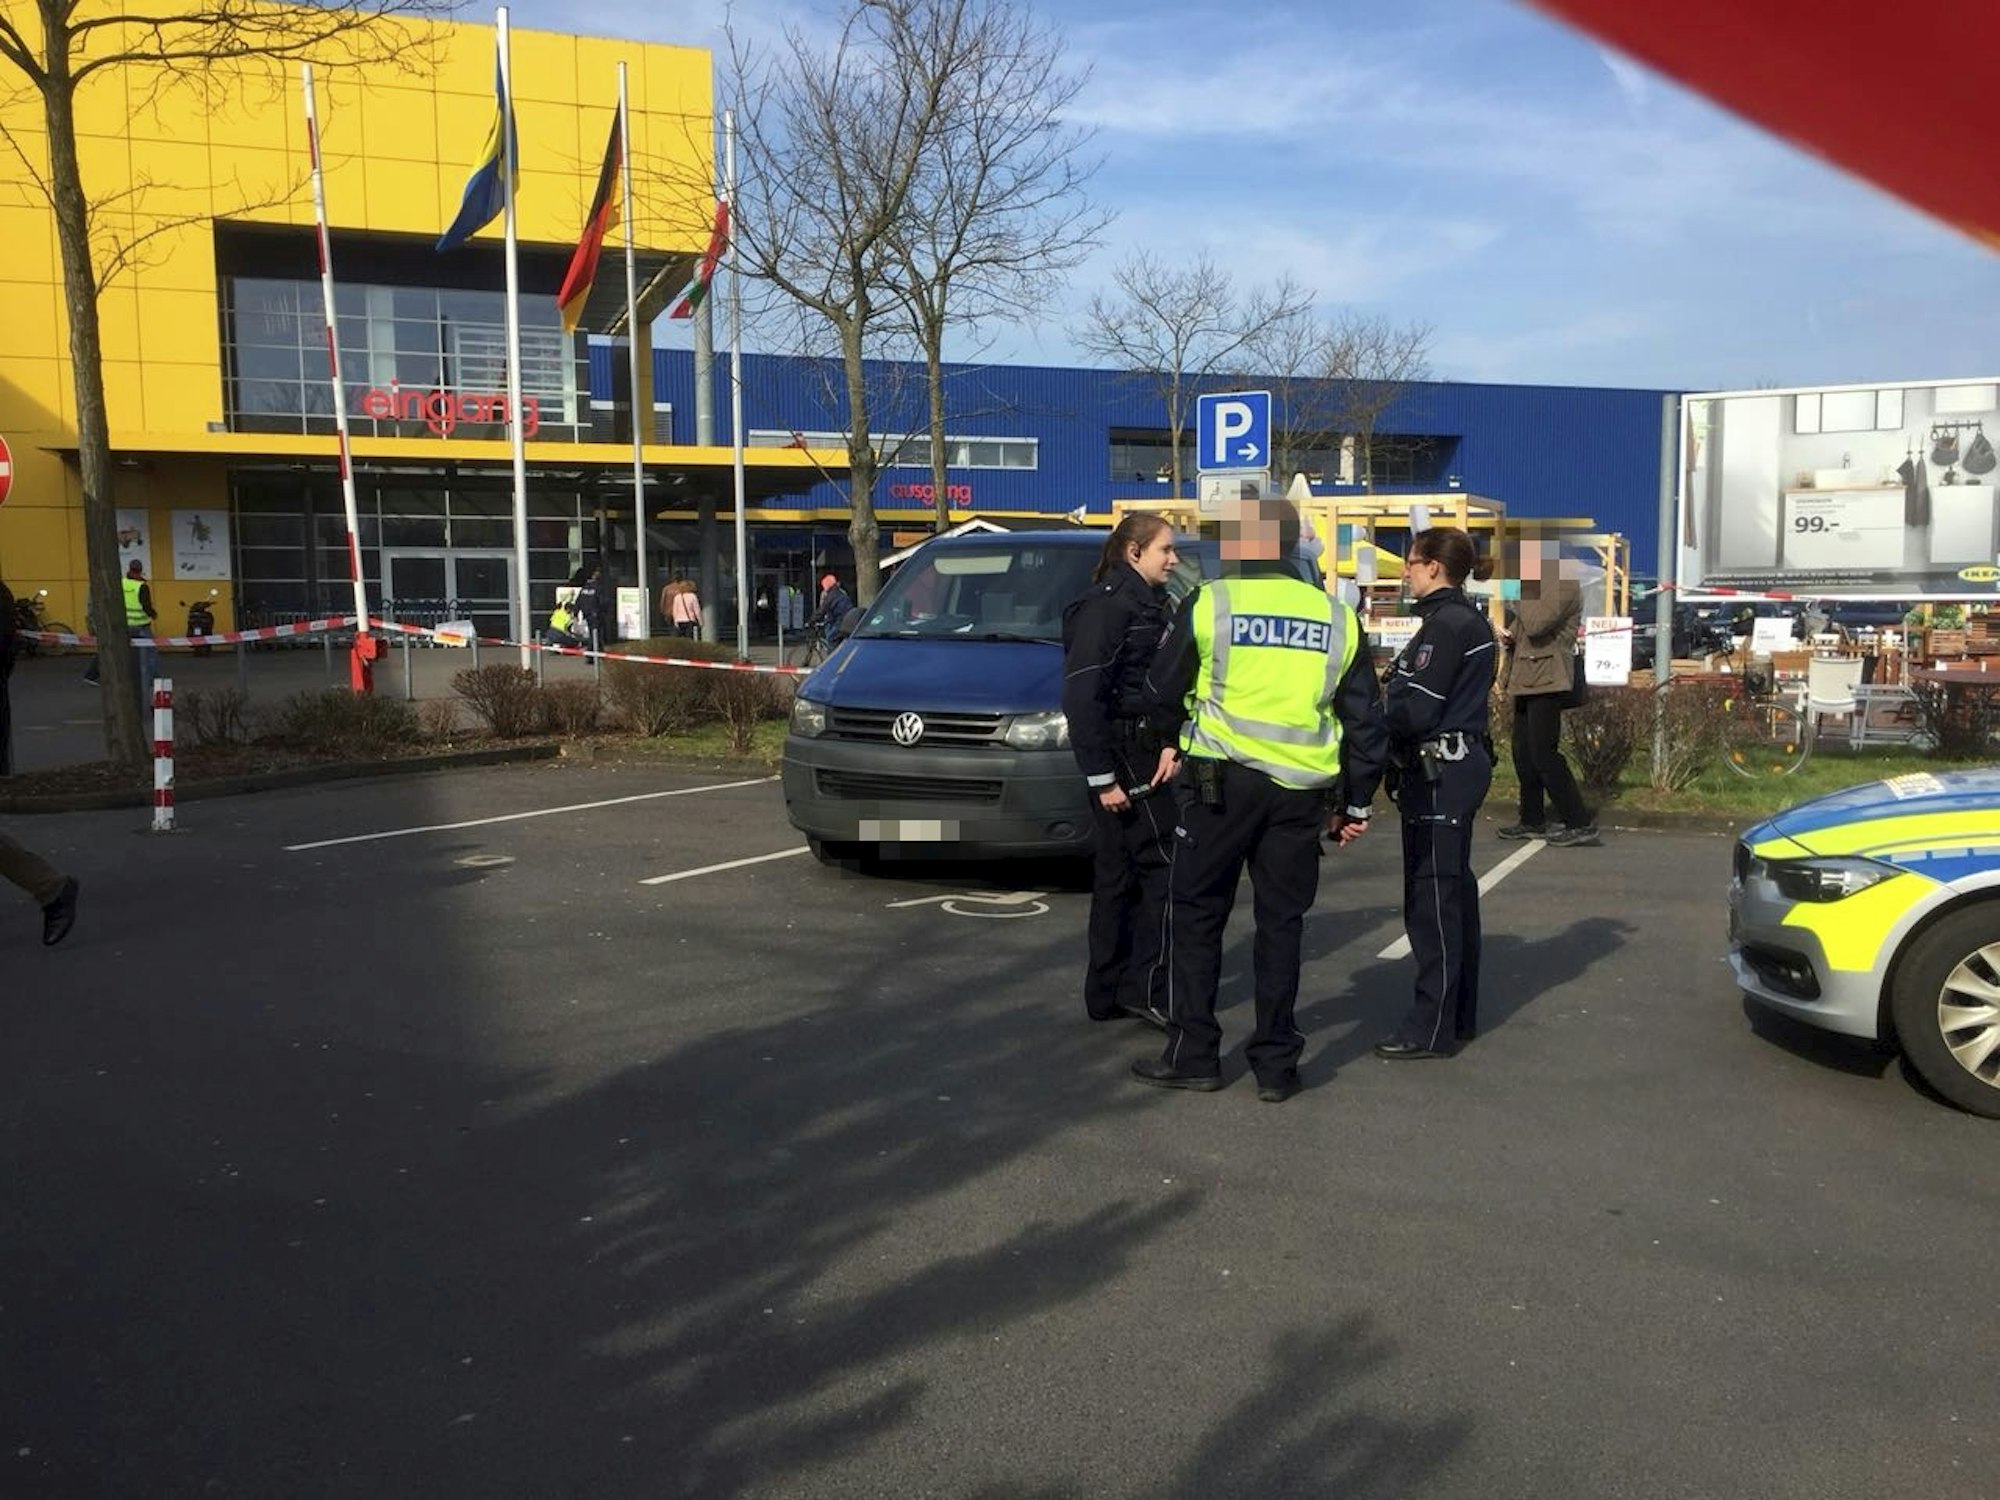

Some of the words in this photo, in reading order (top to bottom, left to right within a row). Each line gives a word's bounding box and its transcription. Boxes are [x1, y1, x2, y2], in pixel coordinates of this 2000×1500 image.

[363, 378, 539, 438] eingang
[1215, 402, 1252, 462] P
[1795, 516, 1839, 533] 99.-
[1233, 617, 1330, 651] POLIZEI
